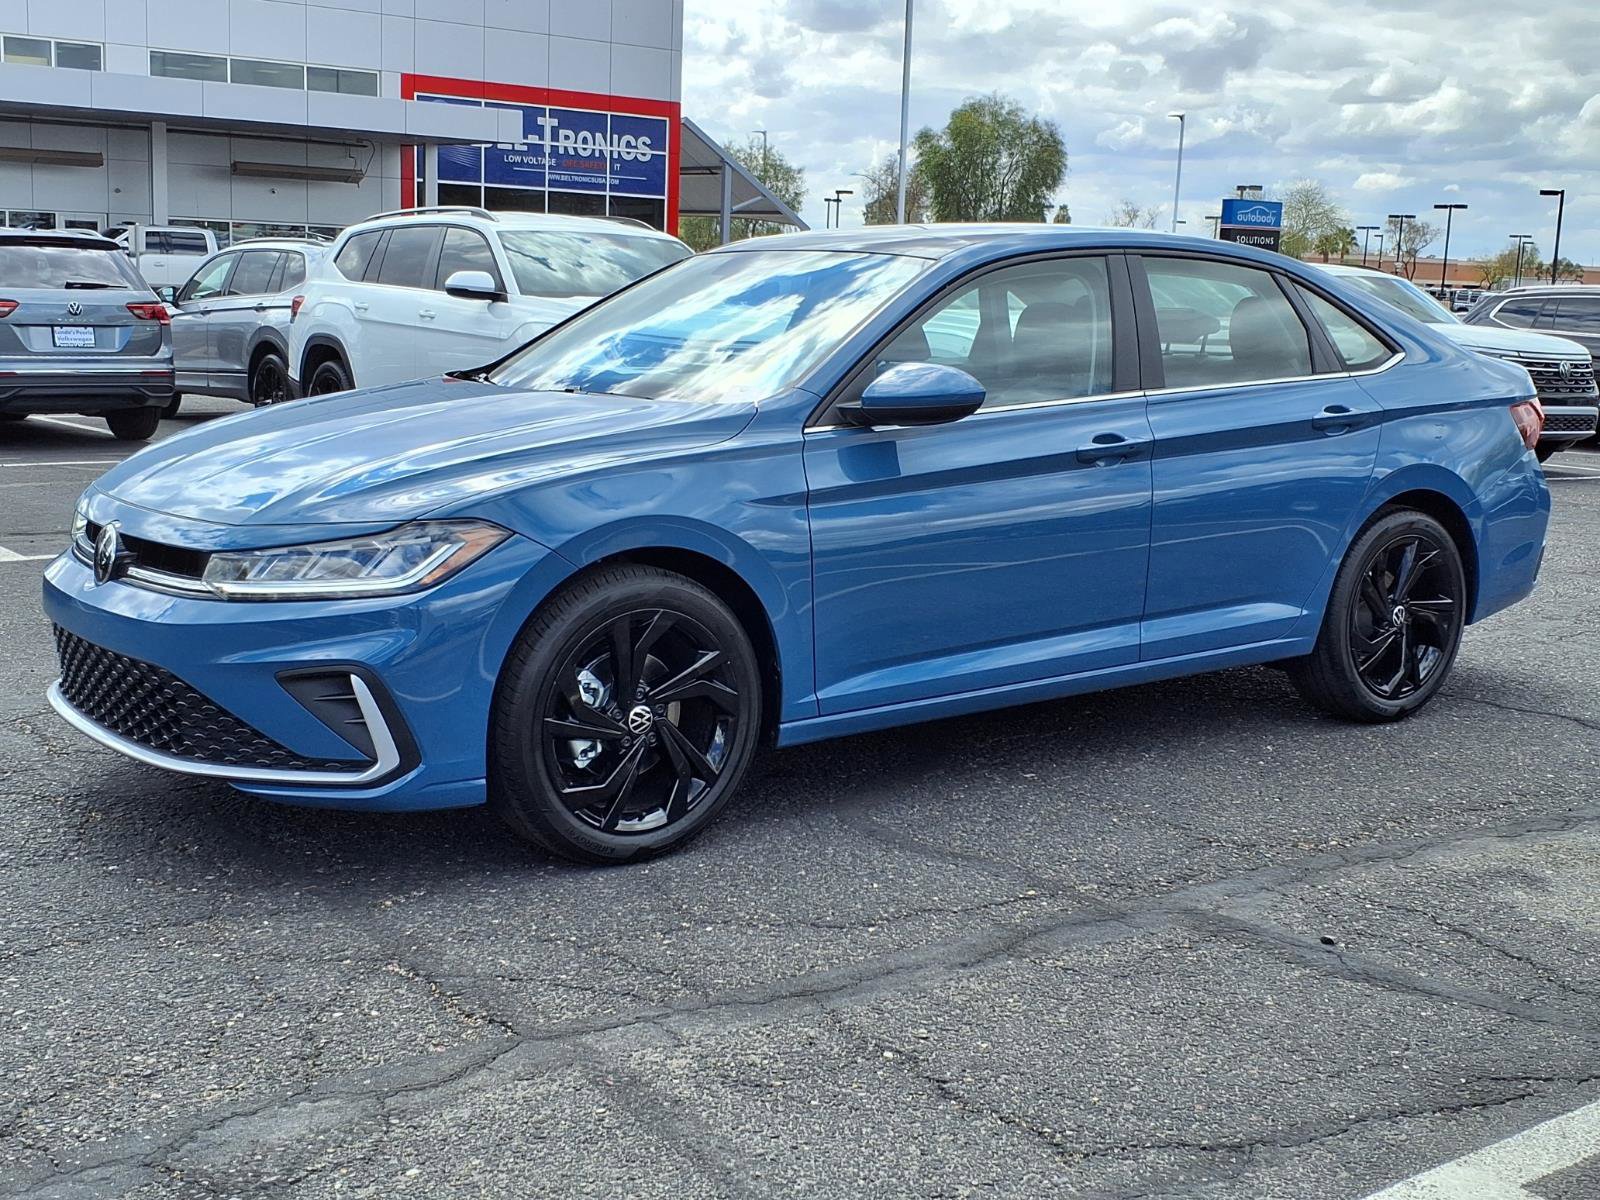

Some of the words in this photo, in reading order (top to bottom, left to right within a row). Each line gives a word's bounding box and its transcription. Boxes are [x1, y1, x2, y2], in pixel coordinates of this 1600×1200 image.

[469, 116, 652, 162] -TRONICS
[503, 154, 522, 163] LOW
[522, 155, 557, 166] VOLTAGE
[614, 163, 621, 171] IT
[1237, 210, 1276, 226] autobody
[1236, 235, 1274, 245] SOLUTIONS
